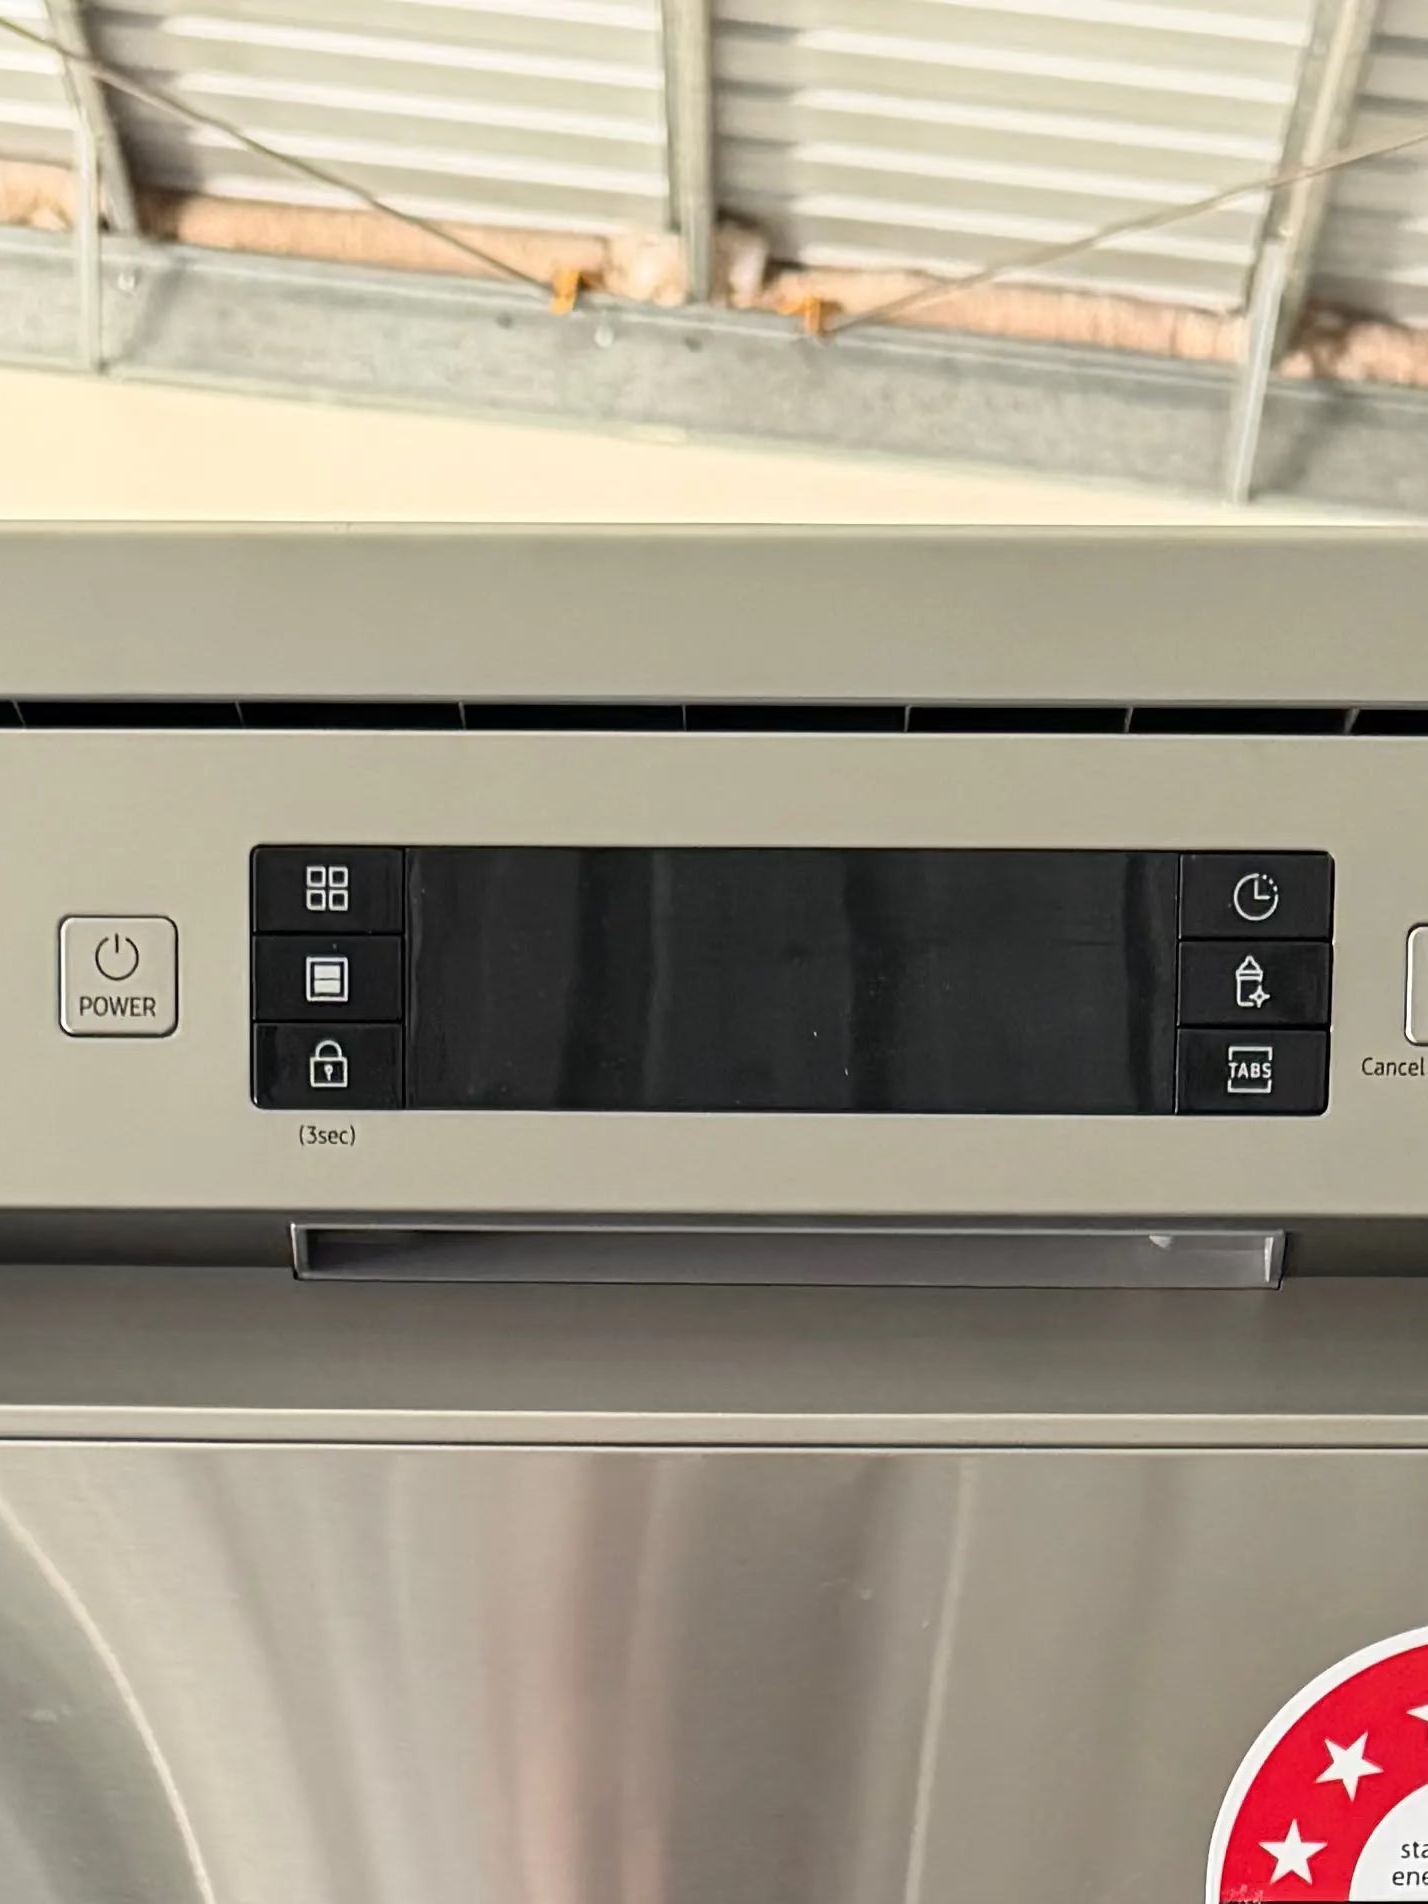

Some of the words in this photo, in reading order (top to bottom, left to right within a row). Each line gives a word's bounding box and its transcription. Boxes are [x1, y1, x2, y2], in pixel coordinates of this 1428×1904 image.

[79, 995, 157, 1018] POWER
[1228, 1060, 1272, 1079] TABS
[1361, 1057, 1425, 1077] Cancel
[298, 1124, 357, 1147] (3sec)
